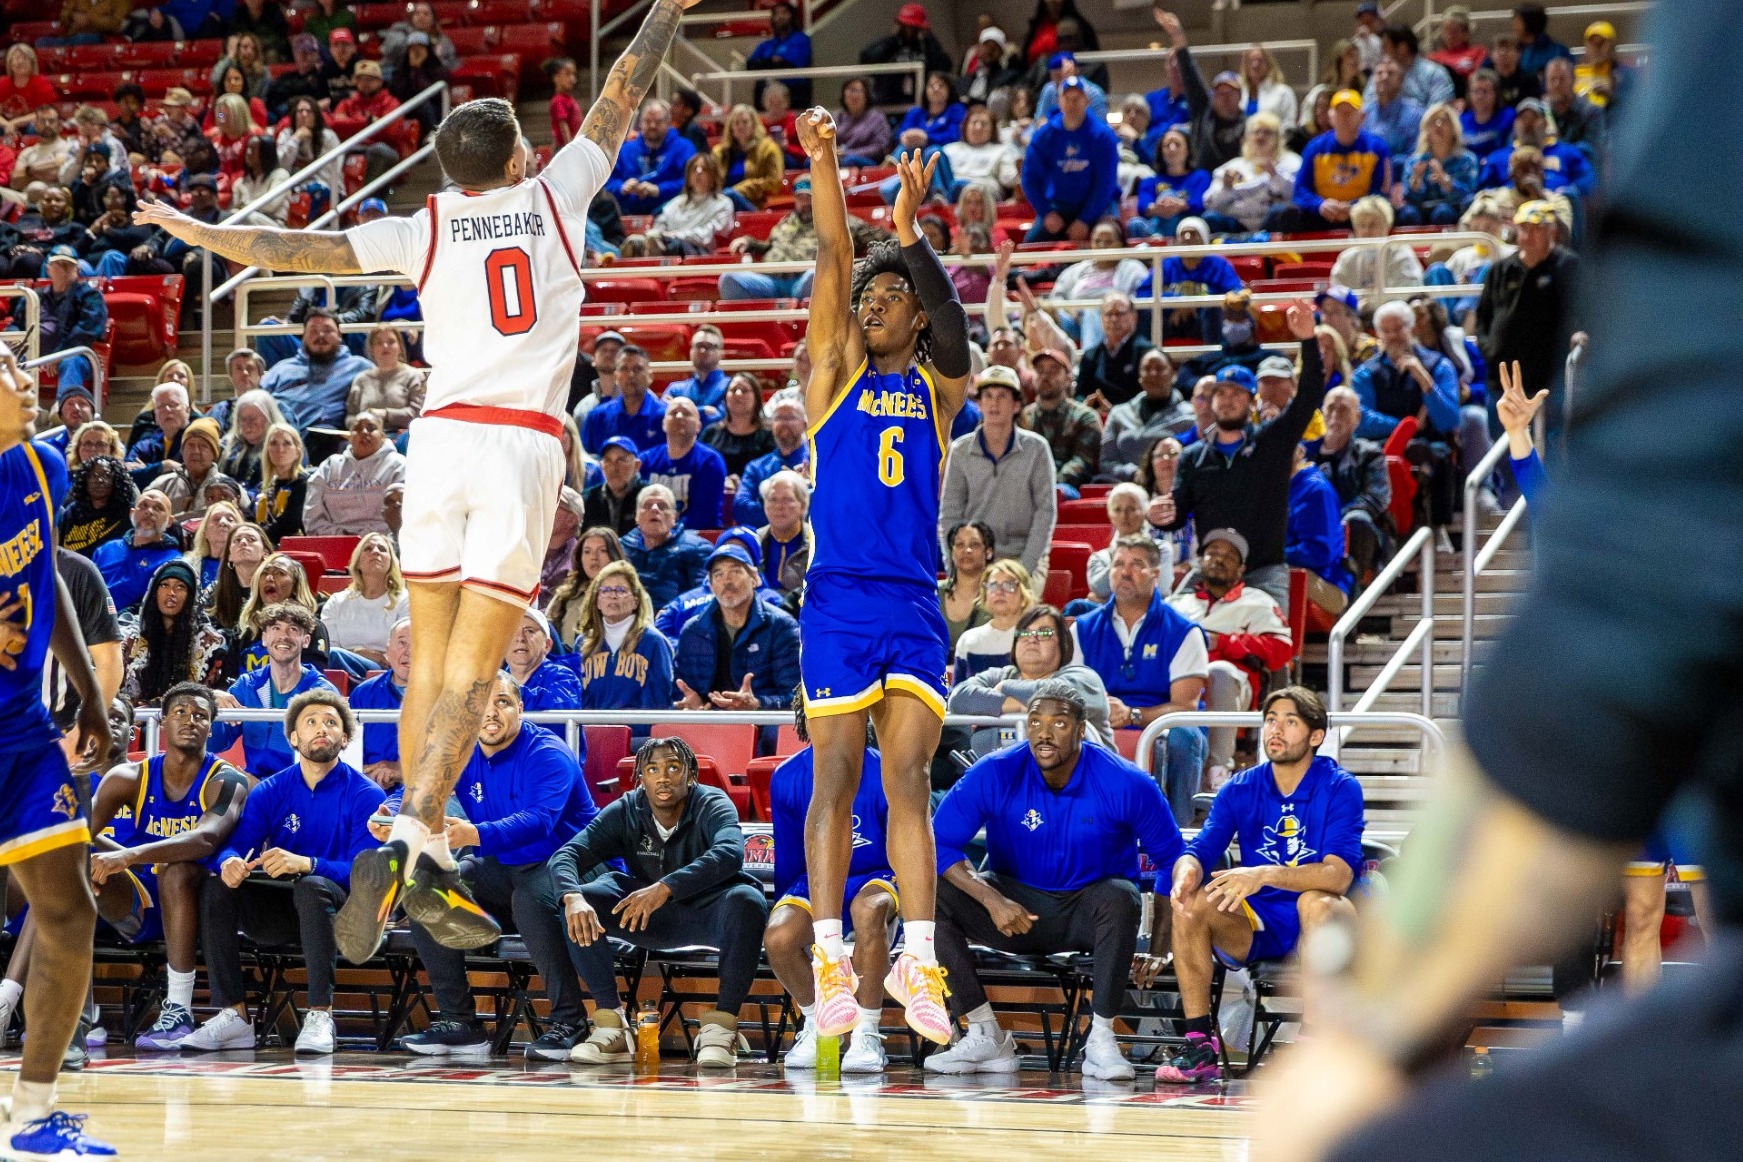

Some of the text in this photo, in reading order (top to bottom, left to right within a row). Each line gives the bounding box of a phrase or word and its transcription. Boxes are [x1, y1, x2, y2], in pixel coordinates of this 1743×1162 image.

[450, 212, 545, 242] PENNEBAKR
[484, 246, 537, 336] 0
[856, 389, 929, 420] McNEES
[877, 425, 905, 488] 6
